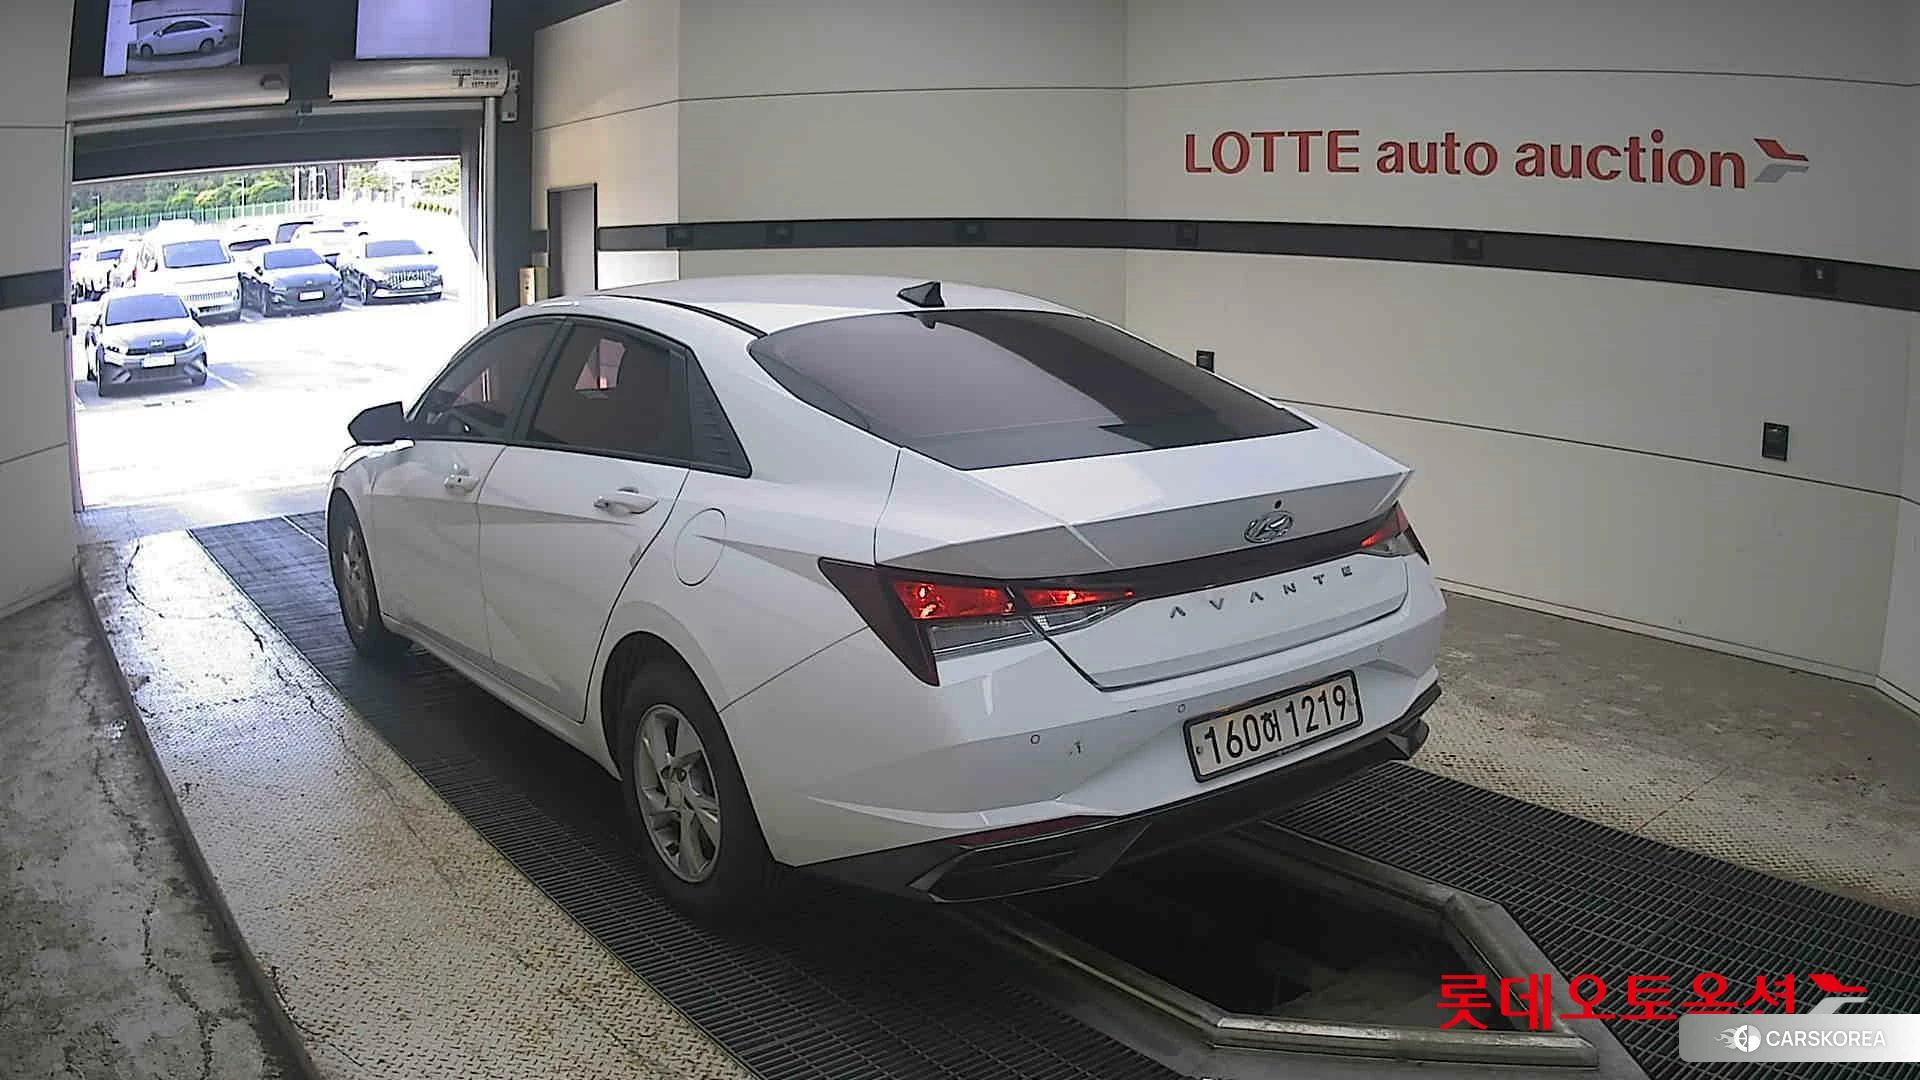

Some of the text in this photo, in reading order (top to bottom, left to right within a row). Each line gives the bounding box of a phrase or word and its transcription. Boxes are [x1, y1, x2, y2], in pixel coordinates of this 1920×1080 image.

[1185, 129, 1746, 188] LOTTE auto auction
[1170, 565, 1353, 618] AVANTE
